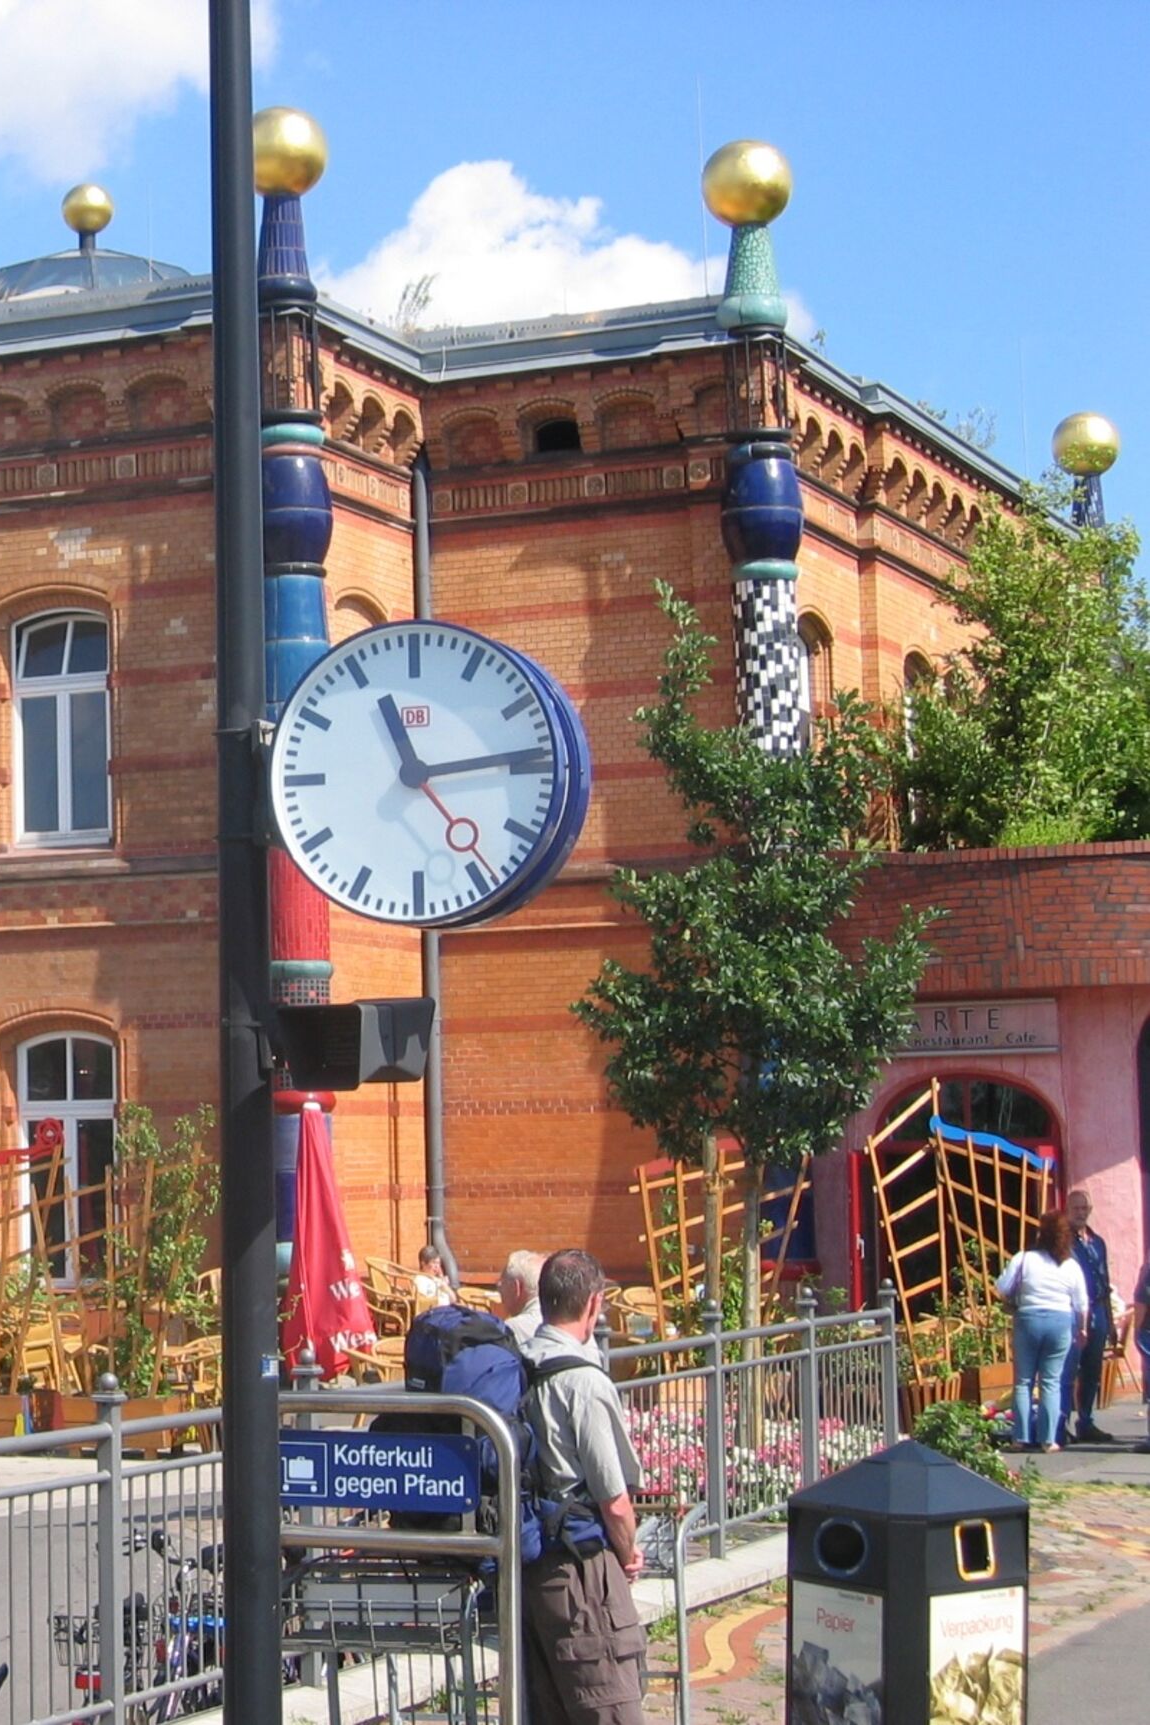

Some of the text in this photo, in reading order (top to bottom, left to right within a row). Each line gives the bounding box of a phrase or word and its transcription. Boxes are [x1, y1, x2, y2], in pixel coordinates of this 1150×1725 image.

[406, 709, 425, 724] DB
[333, 1443, 433, 1468] Kofferkuli
[334, 1474, 465, 1498] gegen Pfand
[816, 1607, 857, 1633] Papier
[939, 1613, 1014, 1640] Verpackung
